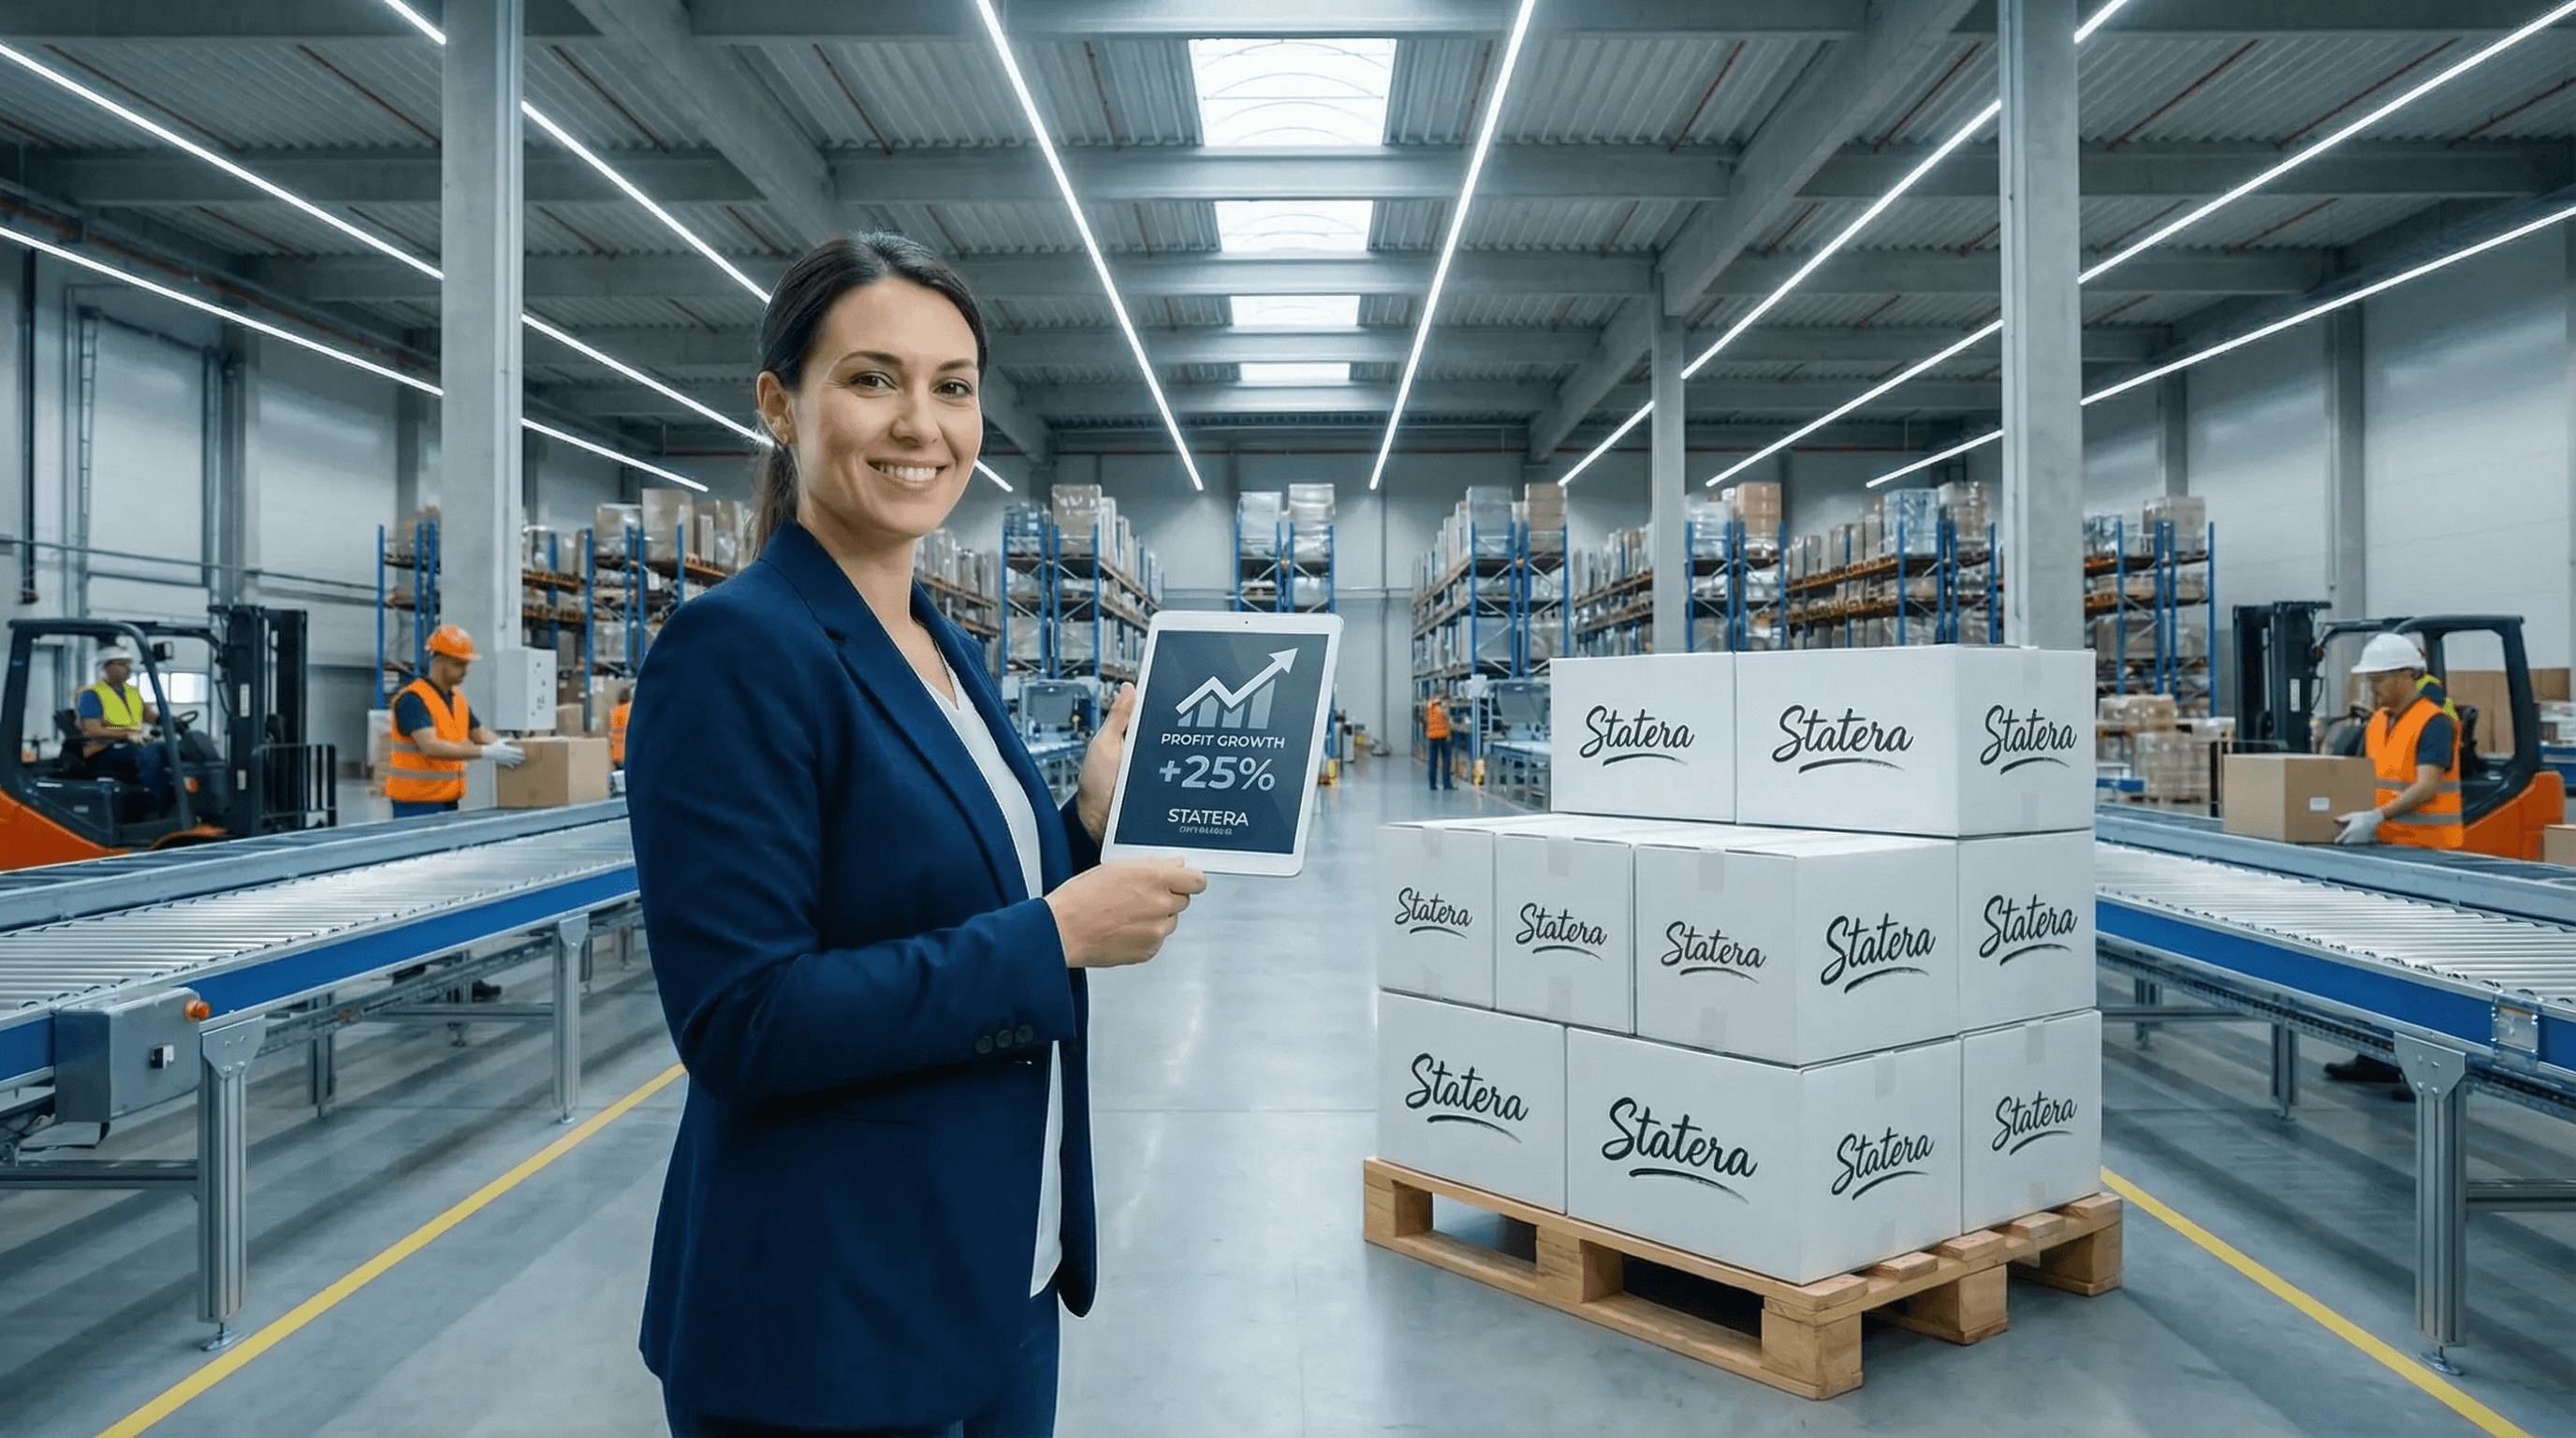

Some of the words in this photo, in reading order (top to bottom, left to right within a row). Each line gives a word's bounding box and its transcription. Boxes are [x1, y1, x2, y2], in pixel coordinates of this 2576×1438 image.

[1161, 733, 1214, 746] PROFIT
[1217, 735, 1285, 749] GROWTH
[1578, 704, 1696, 759] Statera
[1770, 703, 1915, 764] Statera
[1979, 703, 2079, 767] Statera
[1159, 755, 1276, 791] +25%
[1167, 808, 1249, 827] STATERA
[1393, 886, 1474, 929] Statera
[1515, 902, 1609, 947] Statera
[1977, 892, 2079, 960] Statera
[1660, 919, 1768, 970] Statera
[1819, 911, 1938, 987] Statera
[1404, 1051, 1530, 1123] Statera
[1600, 1095, 1759, 1179] Statera
[1990, 1089, 2079, 1152] Statera
[1830, 1125, 1936, 1197] Statera
